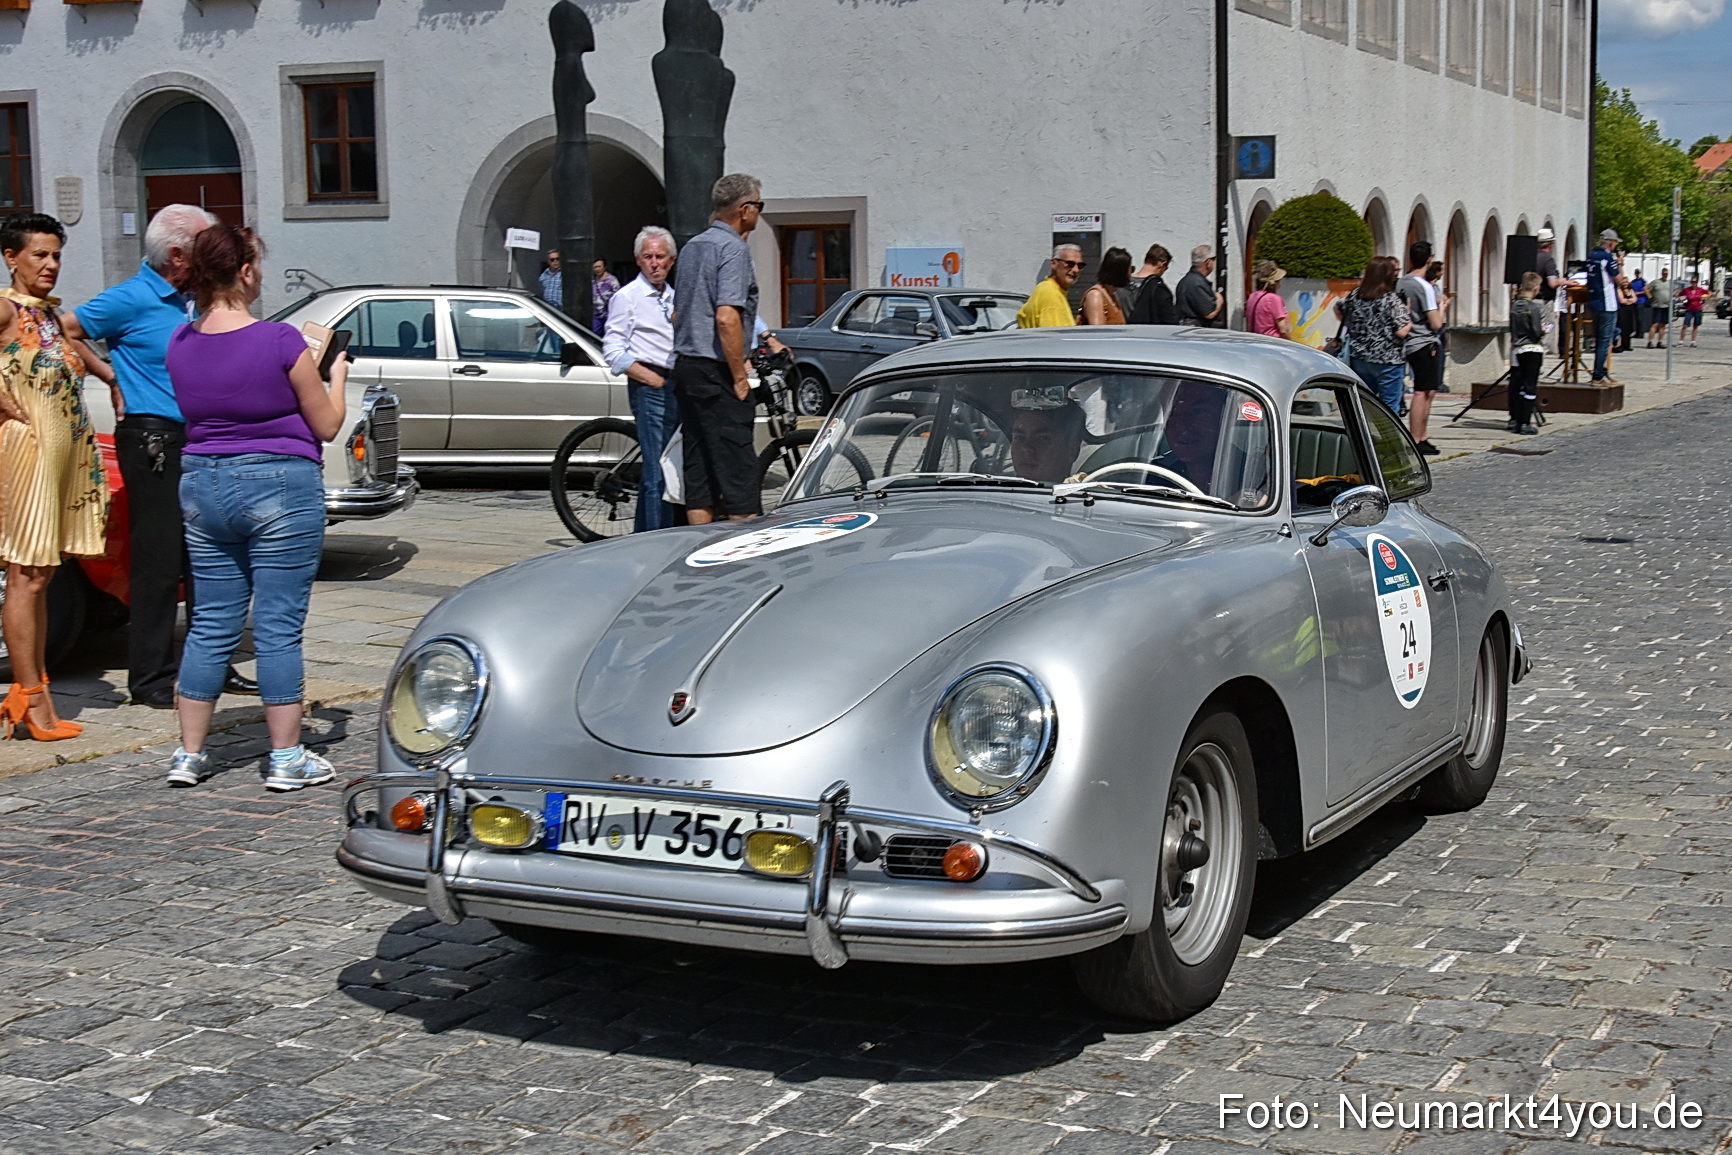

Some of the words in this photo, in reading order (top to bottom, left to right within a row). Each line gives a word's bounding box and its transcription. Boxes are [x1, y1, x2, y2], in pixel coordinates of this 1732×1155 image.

[1054, 215, 1093, 223] NEUMARKT
[891, 273, 940, 287] Kunst
[1400, 620, 1416, 658] 24
[561, 801, 606, 846] RV
[633, 806, 655, 851] V
